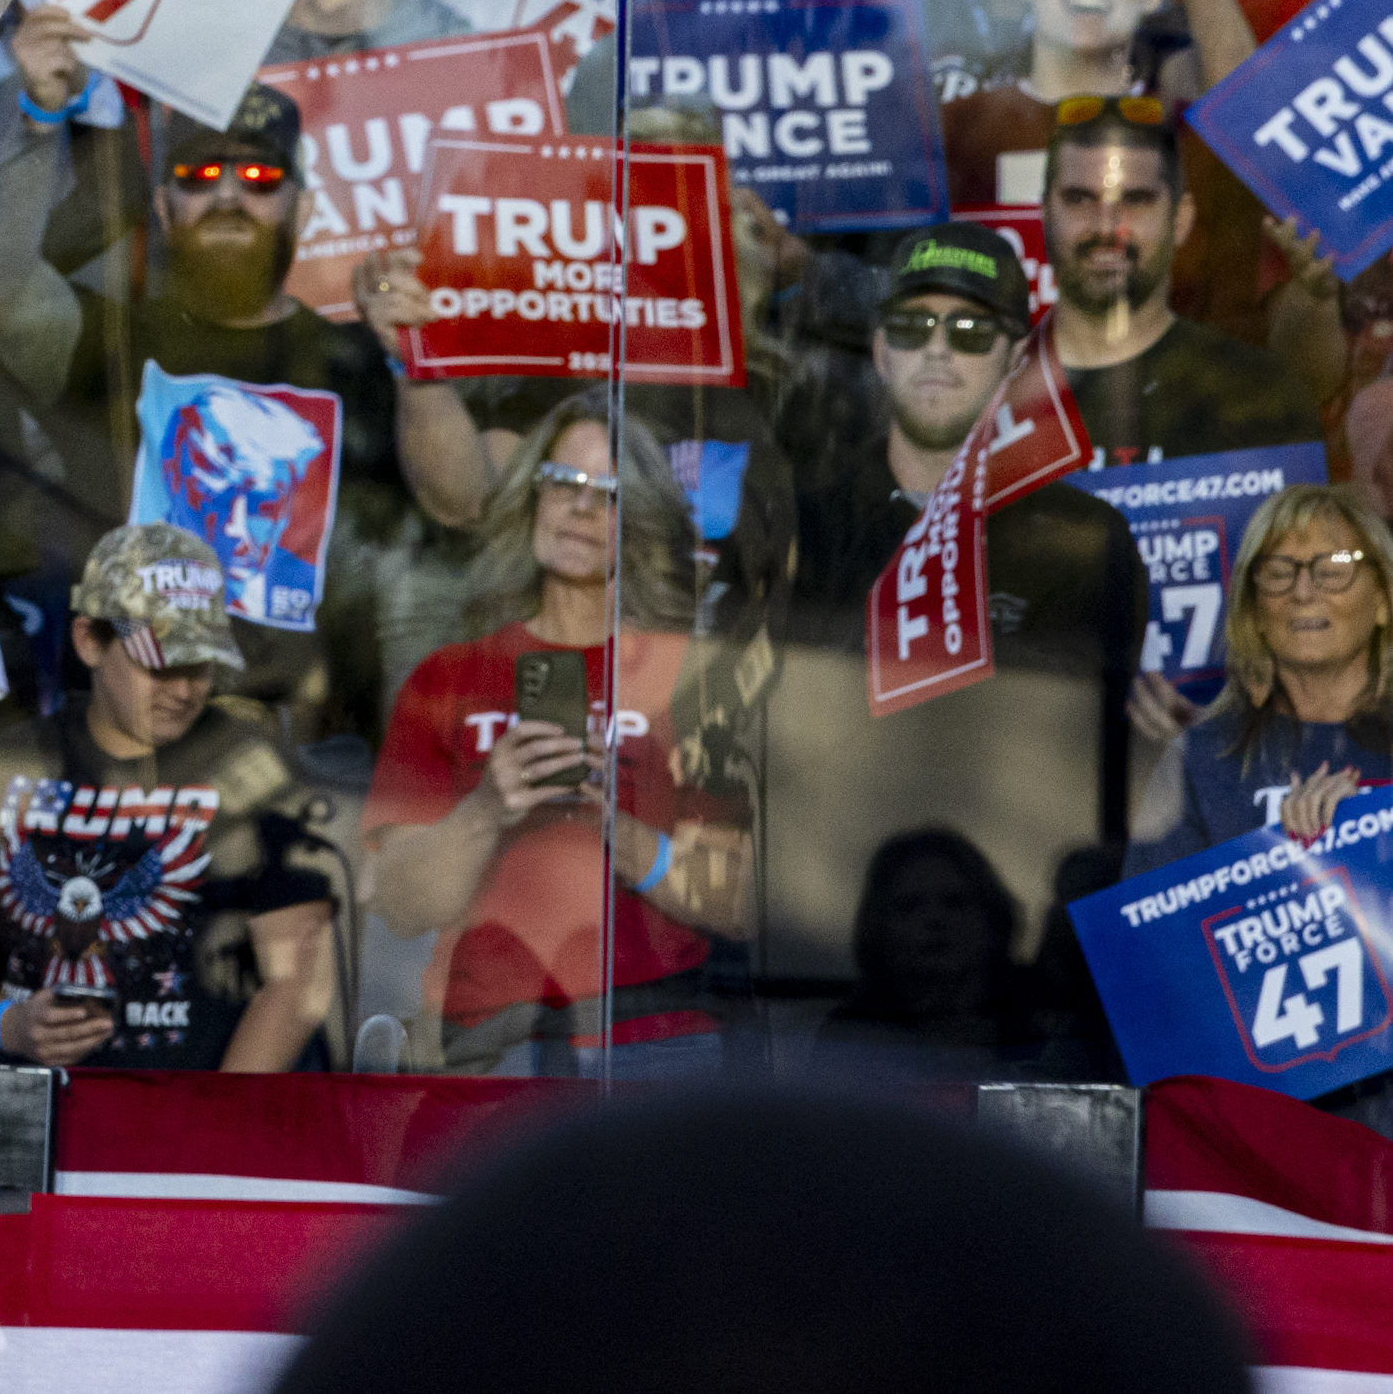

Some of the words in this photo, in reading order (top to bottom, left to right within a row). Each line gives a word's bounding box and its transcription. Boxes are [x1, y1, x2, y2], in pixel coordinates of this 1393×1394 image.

[1253, 15, 1393, 164] TRU
[721, 108, 872, 158] NCE
[437, 193, 687, 266] TRUP
[1138, 529, 1219, 564] UMP
[1149, 557, 1210, 583] RCE
[1214, 883, 1348, 958] TRUMP
[1234, 914, 1346, 974] FORCE
[125, 1002, 190, 1027] BACK
[1251, 936, 1364, 1051] 47
